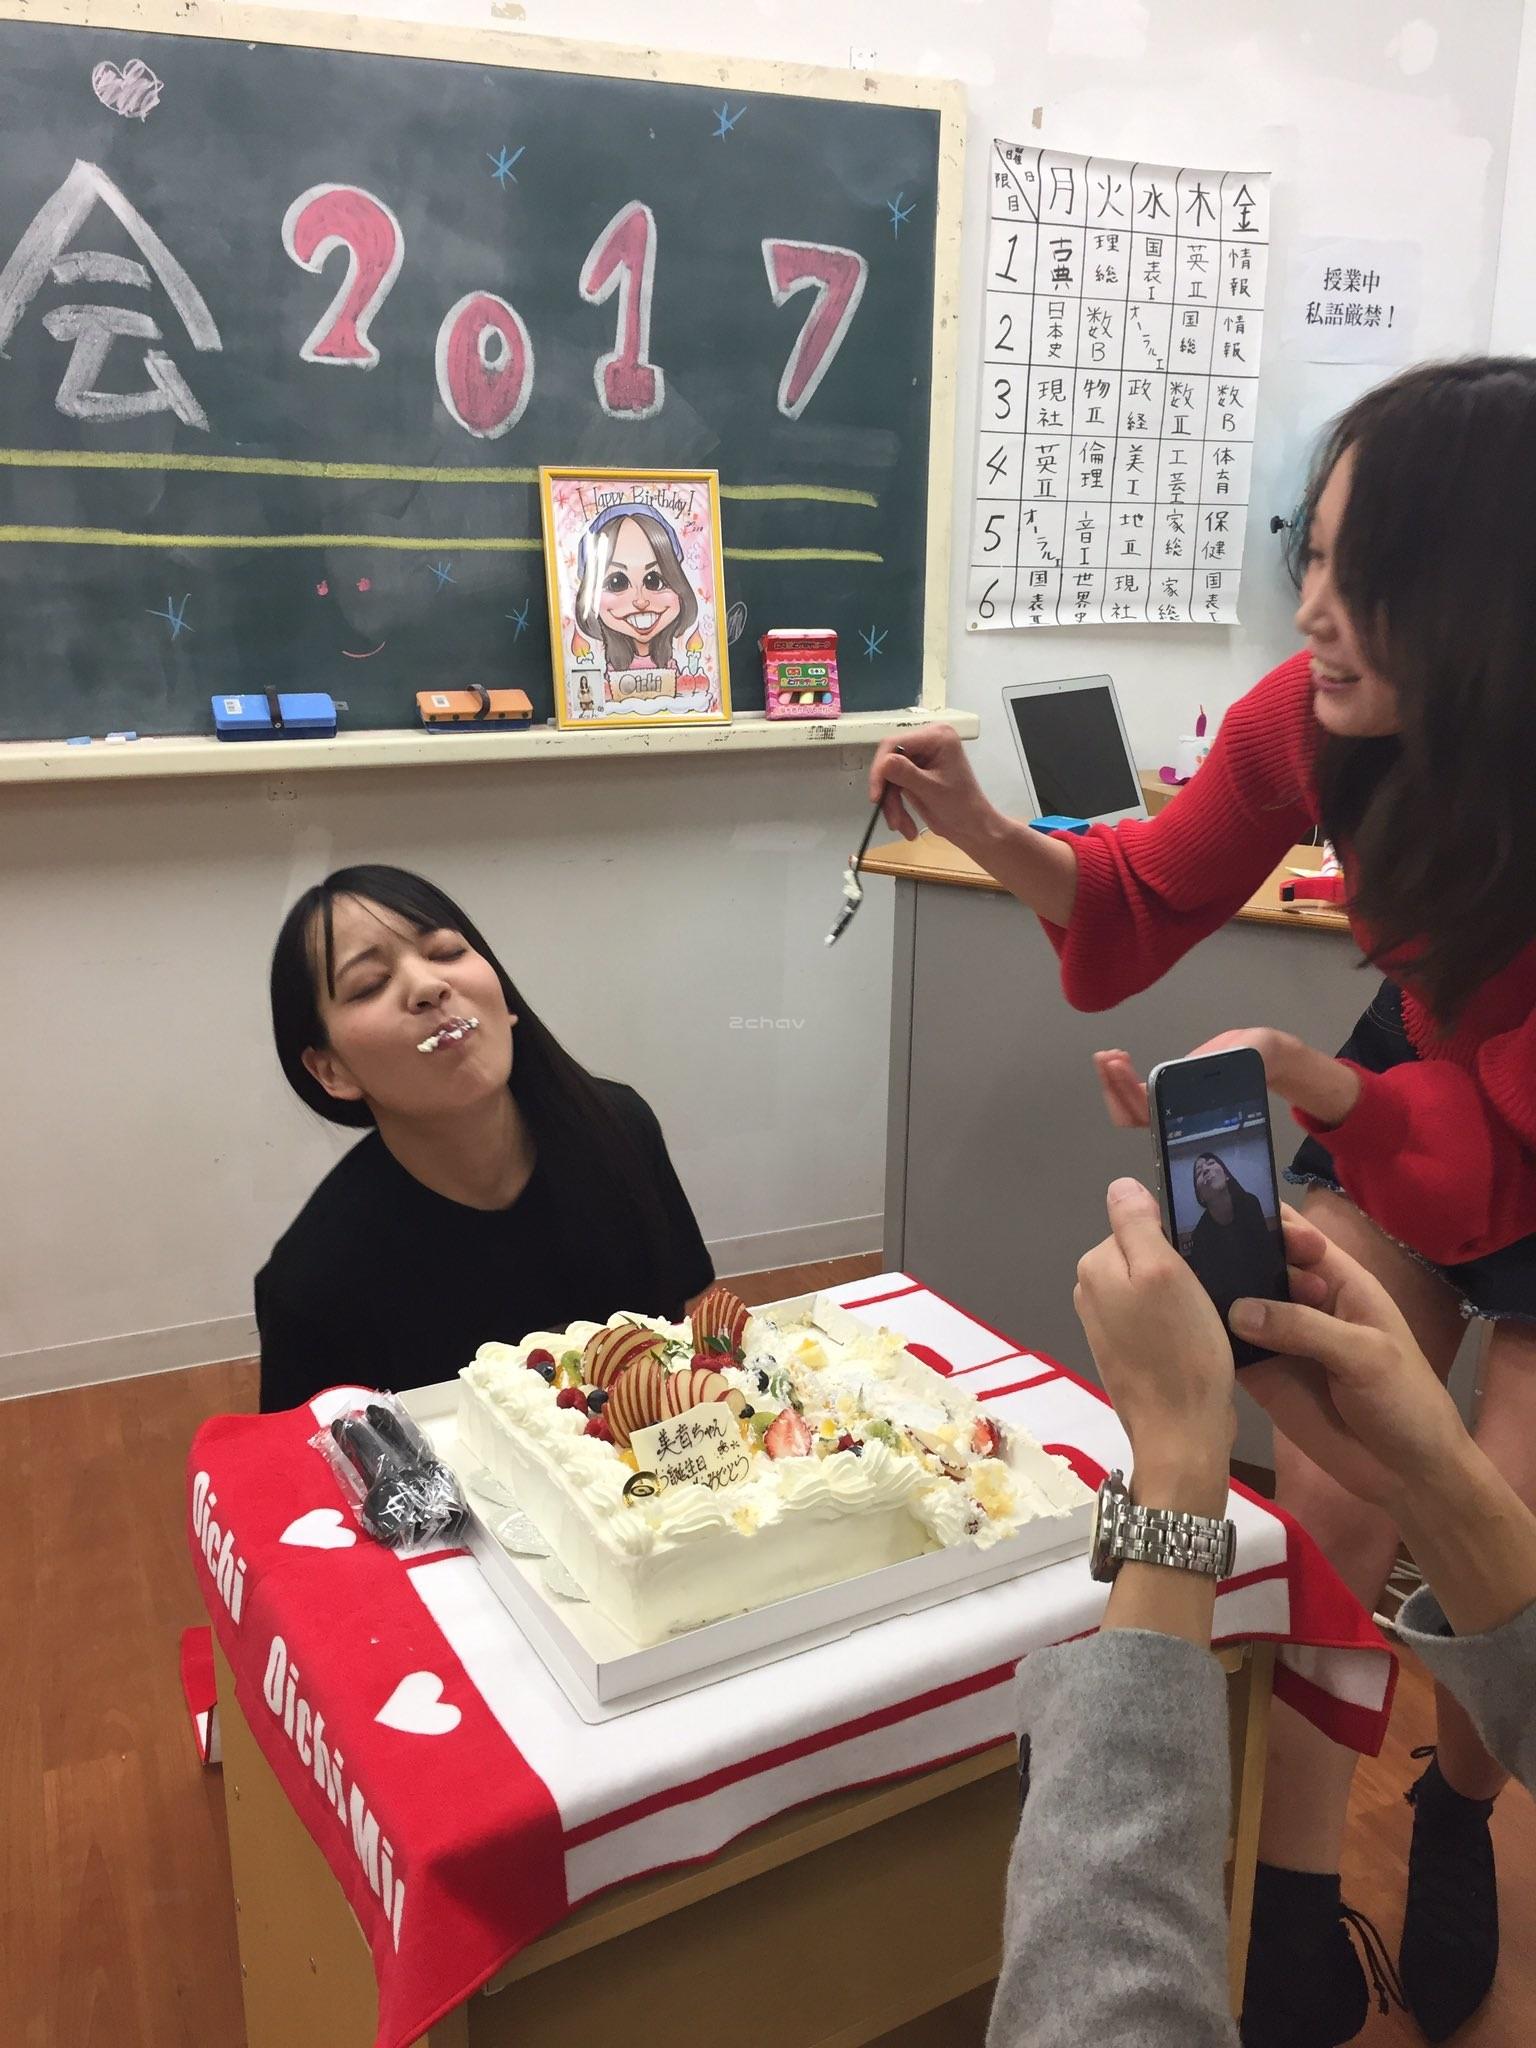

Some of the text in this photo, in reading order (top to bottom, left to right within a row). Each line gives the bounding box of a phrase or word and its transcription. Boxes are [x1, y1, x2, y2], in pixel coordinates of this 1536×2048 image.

[1049, 167, 1259, 232] 月 火 水 木 金
[995, 234, 1018, 283] 1
[1049, 237, 1073, 291] 古典
[1094, 234, 1119, 283] 理総
[1229, 248, 1251, 297] 情報
[1324, 267, 1380, 293] 授業中
[0, 160, 868, 439] 会 2017
[995, 314, 1014, 351] 2
[1047, 302, 1065, 358] 日本史
[1087, 307, 1112, 361] 数B
[1180, 311, 1199, 354] 国総
[1224, 315, 1245, 362] 情報
[995, 379, 1011, 419] 3
[1037, 379, 1066, 427] 現社
[1127, 379, 1151, 431] 政経
[1218, 385, 1243, 432] 数B
[986, 445, 1007, 485] 4
[1079, 441, 1106, 488] 倫理
[1213, 448, 1235, 494] 体育
[576, 486, 695, 521] Happy Birthday!
[984, 515, 1005, 551] 5
[1165, 508, 1185, 556] 家総
[1202, 511, 1229, 560] 保健
[979, 579, 999, 618] 6
[1112, 574, 1139, 619] 現社
[1158, 577, 1179, 620] 家総
[656, 1418, 728, 1461] 美音ちゃん
[192, 1471, 247, 1626] Oichi
[263, 1636, 347, 1828] Oichi
